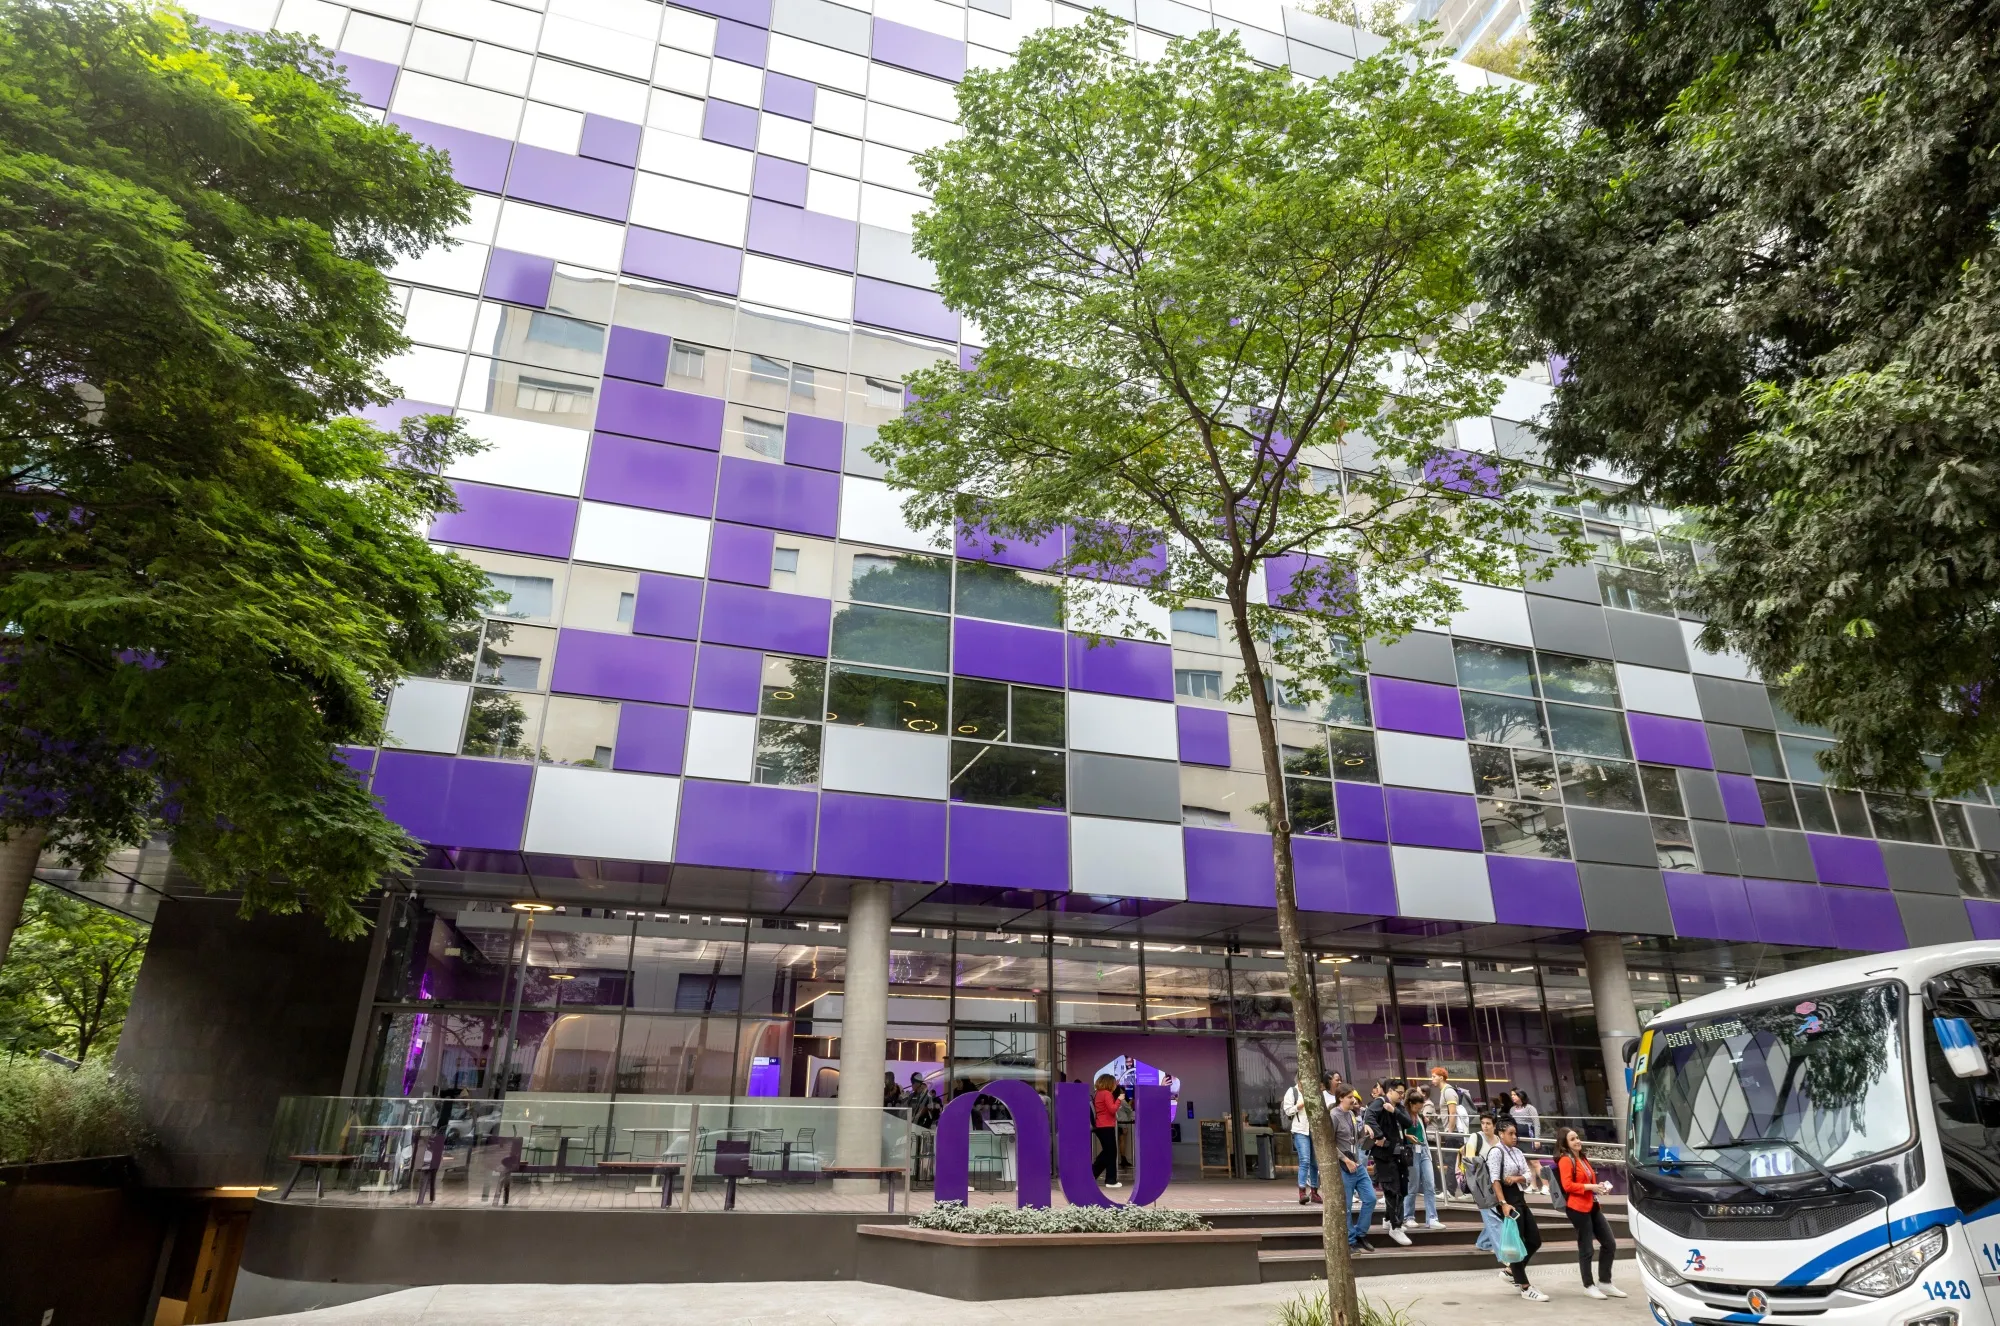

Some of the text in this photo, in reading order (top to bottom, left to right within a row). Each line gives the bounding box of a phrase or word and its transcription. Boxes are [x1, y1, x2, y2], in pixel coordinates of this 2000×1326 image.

[1666, 1020, 1745, 1048] BOA VIAGEM
[1637, 1056, 1645, 1071] F
[1707, 1204, 1774, 1216] Marcopolo
[1923, 1280, 1971, 1300] 1420
